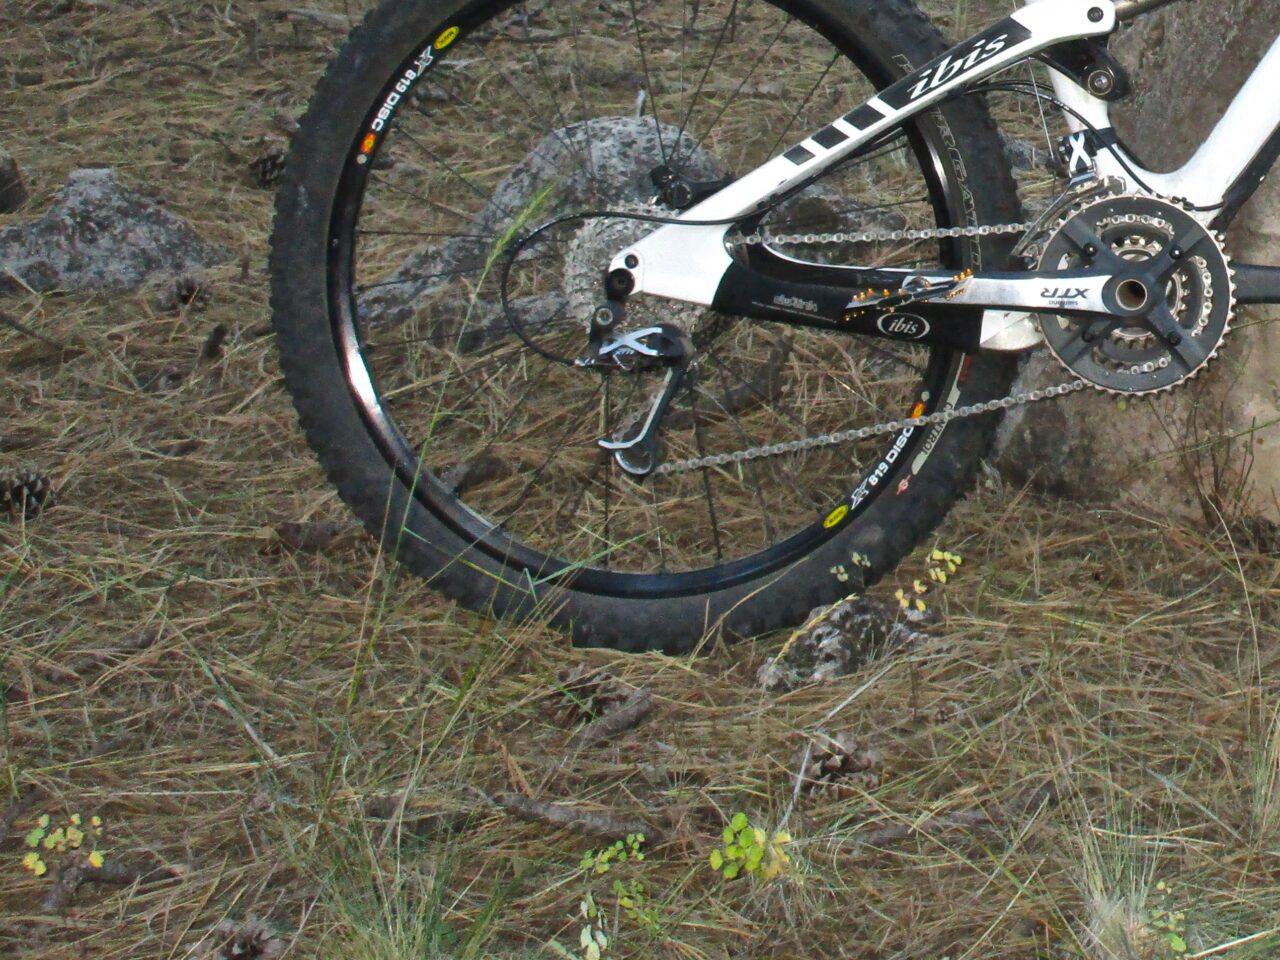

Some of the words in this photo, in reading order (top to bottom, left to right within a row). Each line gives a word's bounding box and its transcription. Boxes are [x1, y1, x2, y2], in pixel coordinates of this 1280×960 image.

[395, 69, 417, 93] 819
[907, 33, 1008, 100] ibis
[371, 91, 401, 132] DISC
[1040, 287, 1091, 299] XTR
[888, 317, 919, 334] ibis
[868, 461, 889, 486] 819
[885, 426, 915, 464] DISC
